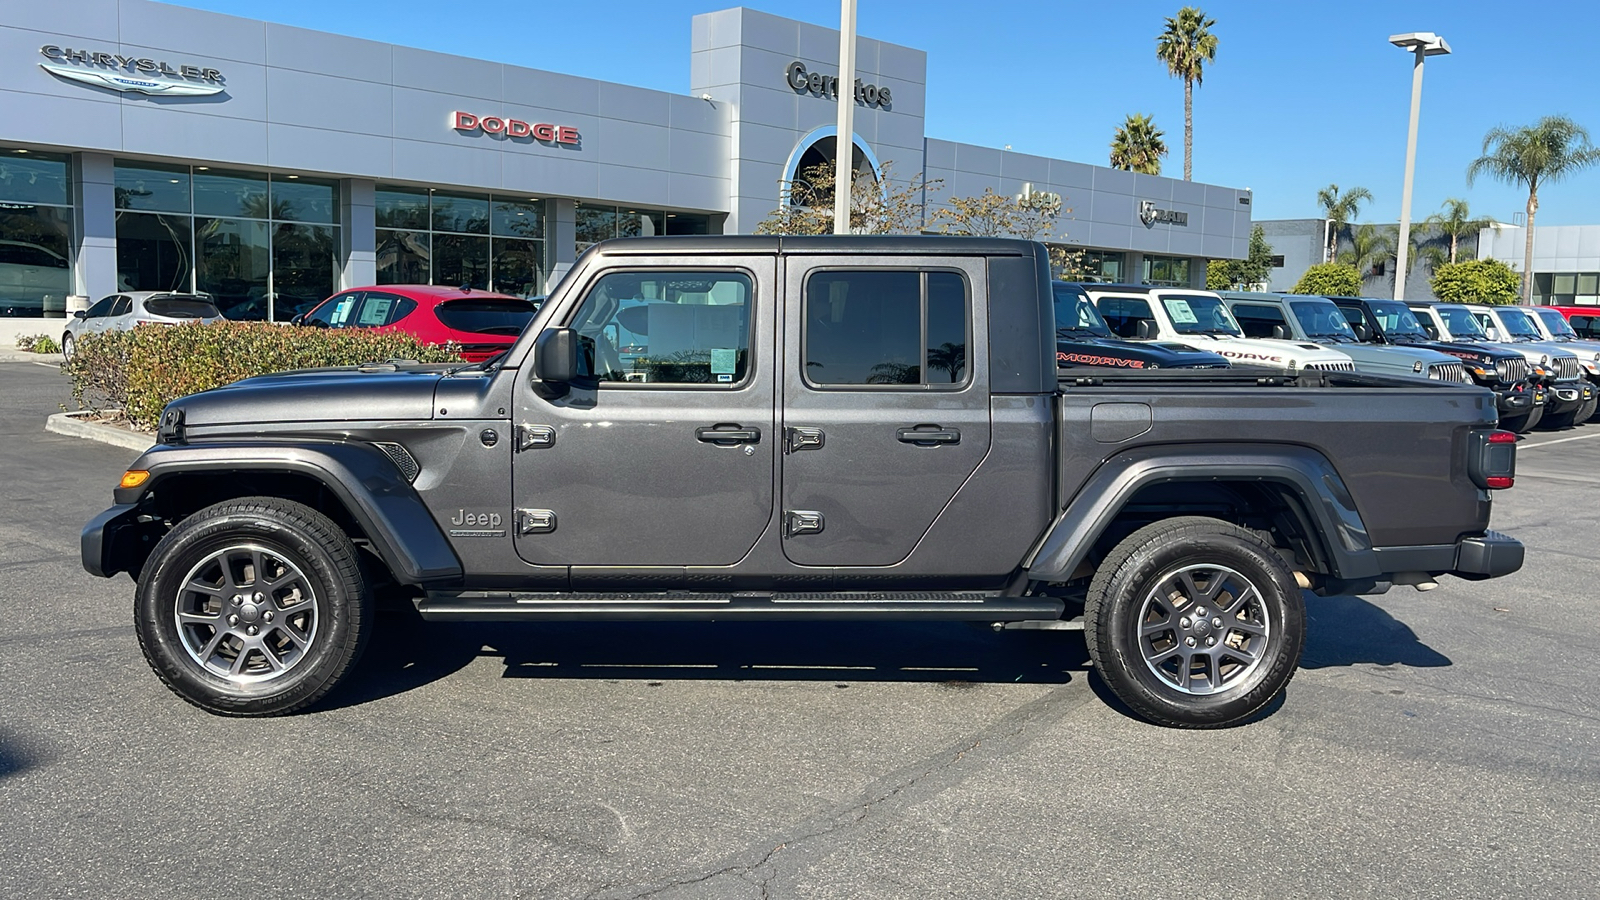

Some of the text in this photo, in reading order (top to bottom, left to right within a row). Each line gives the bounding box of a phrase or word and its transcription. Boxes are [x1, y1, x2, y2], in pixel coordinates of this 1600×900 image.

[40, 45, 221, 81] CHRYSLER
[786, 61, 892, 106] Cerrtos
[453, 111, 578, 144] DODGE
[1155, 208, 1188, 224] RAM
[1056, 352, 1144, 369] MOJAVE
[451, 509, 502, 529] Jeep
